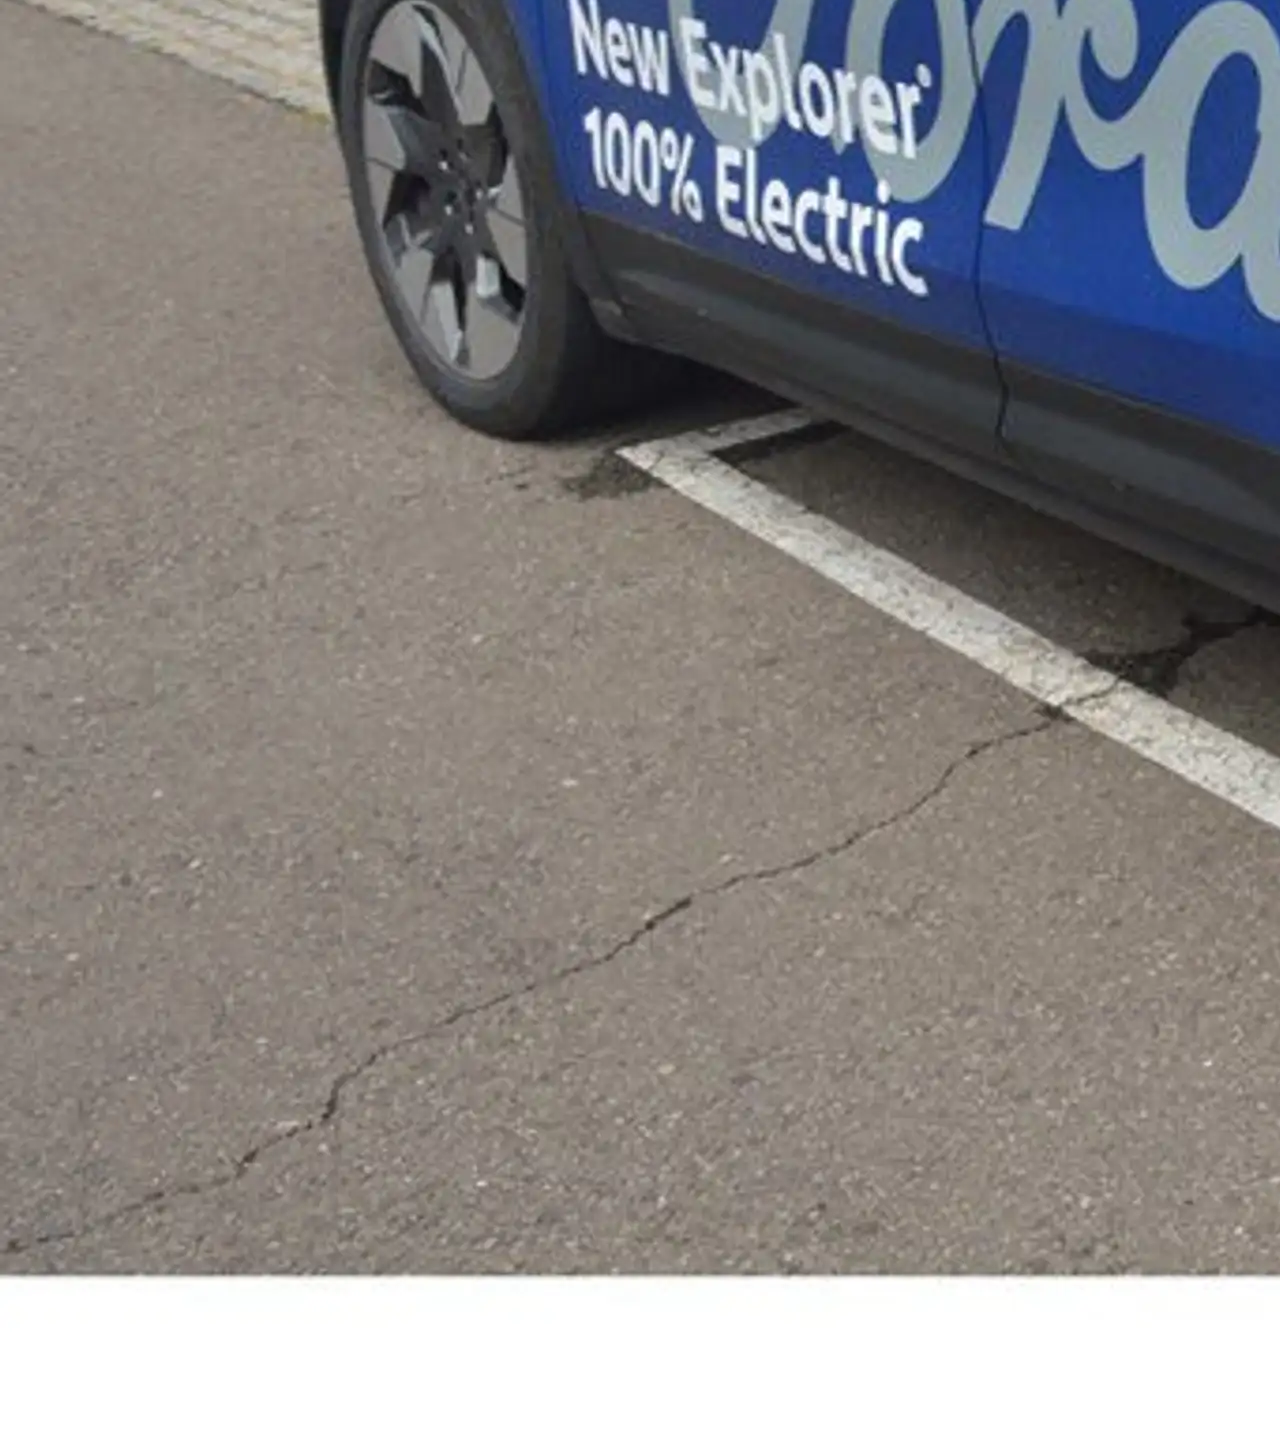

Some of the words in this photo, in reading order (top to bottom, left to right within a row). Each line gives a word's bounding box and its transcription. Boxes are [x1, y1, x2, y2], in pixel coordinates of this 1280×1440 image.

[679, 16, 924, 160] Explorer
[583, 106, 704, 223] 100%
[716, 145, 929, 298] Electric
